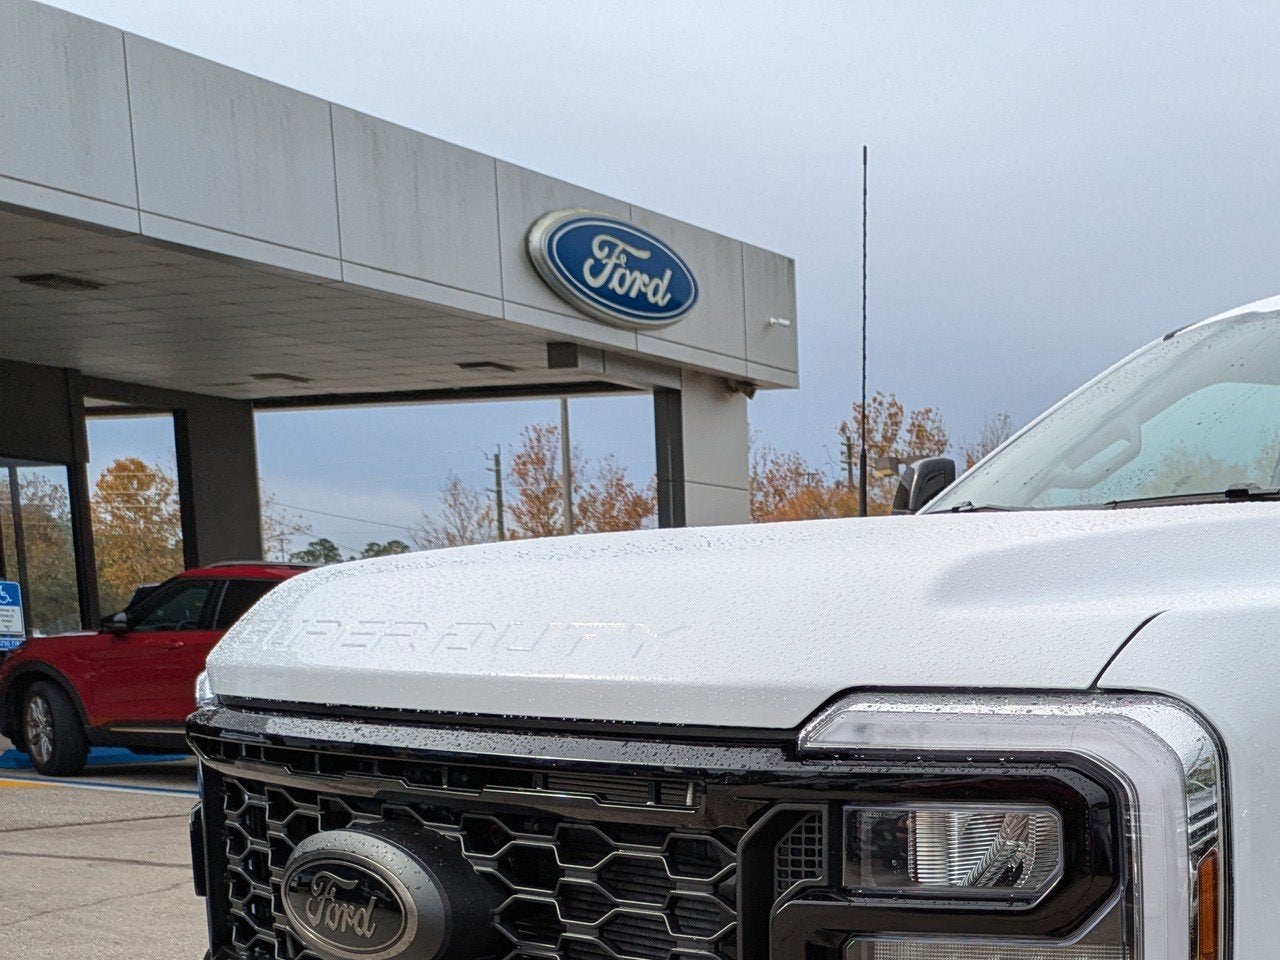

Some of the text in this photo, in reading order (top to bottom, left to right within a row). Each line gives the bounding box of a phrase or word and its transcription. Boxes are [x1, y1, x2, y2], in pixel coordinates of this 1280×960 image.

[583, 234, 672, 307] Ford
[432, 620, 694, 659] DUTY
[305, 870, 377, 939] Ford
